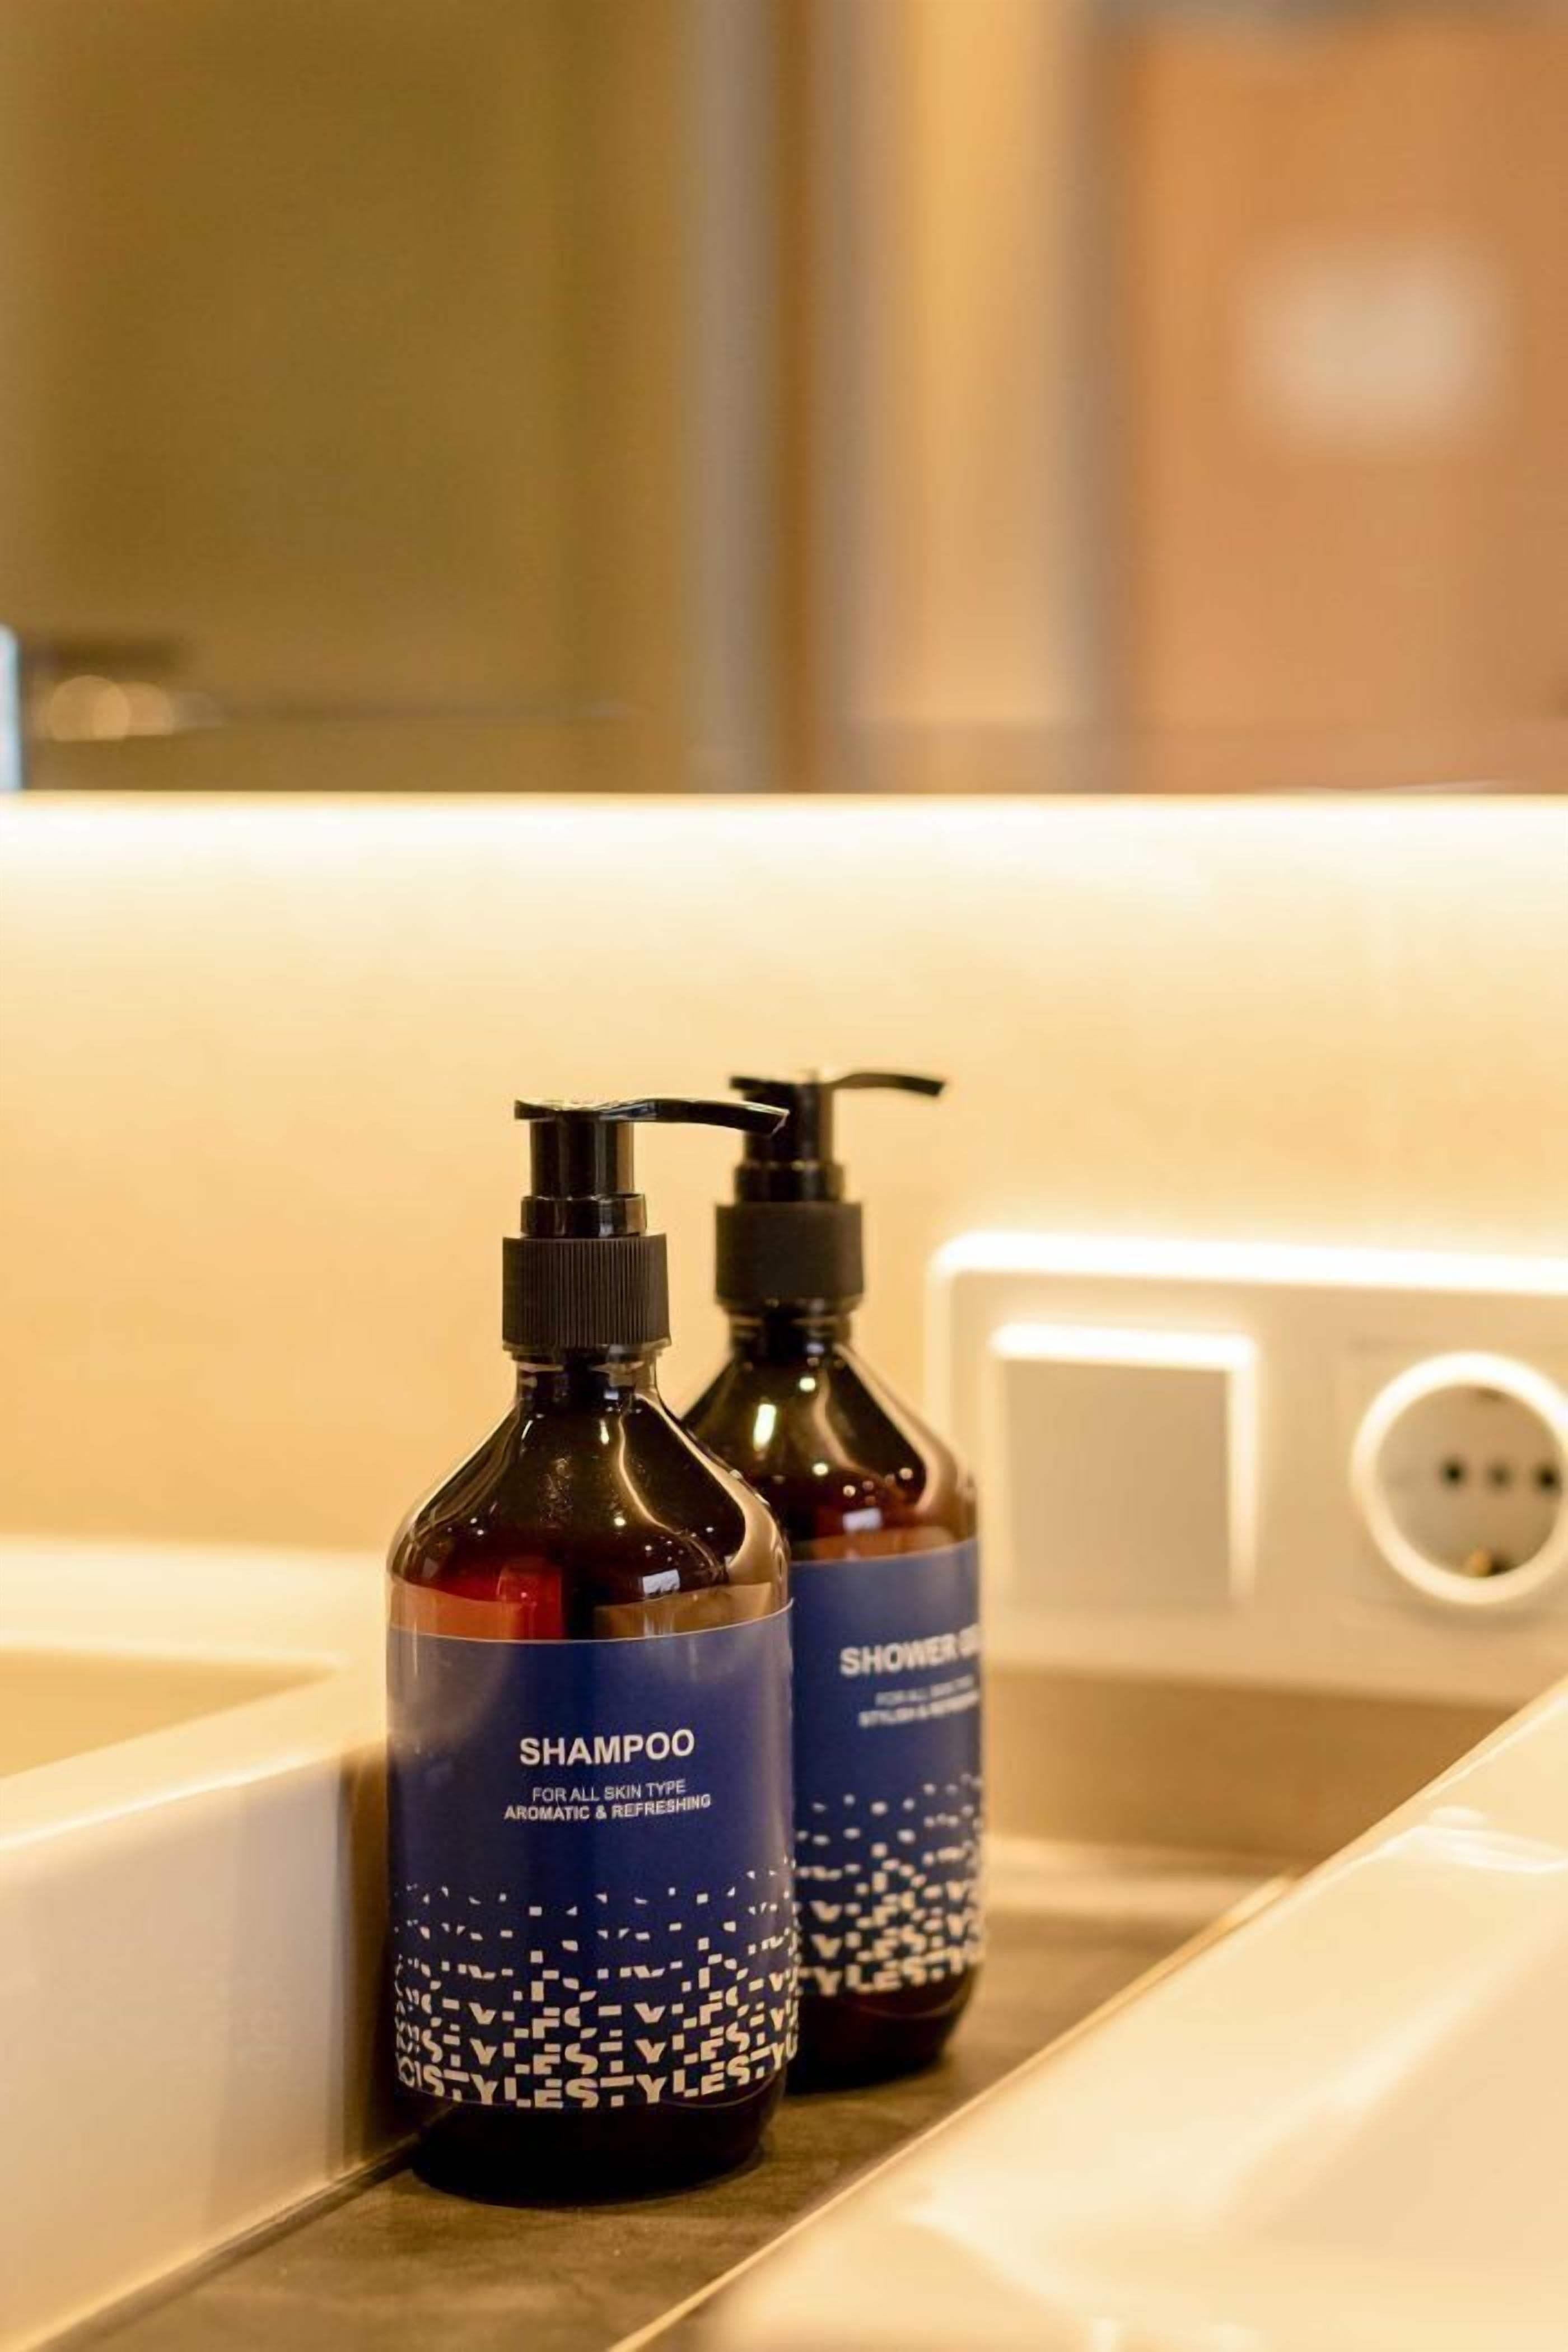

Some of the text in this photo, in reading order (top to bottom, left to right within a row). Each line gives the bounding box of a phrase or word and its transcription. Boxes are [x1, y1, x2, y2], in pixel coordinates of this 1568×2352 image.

[840, 1632, 956, 1677] SHOWER
[520, 1729, 695, 1765] SHAMPOO
[533, 1779, 686, 1803] FOR ALL SKIN TYPE
[505, 1794, 711, 1821] AROMATIC & REFRESHING
